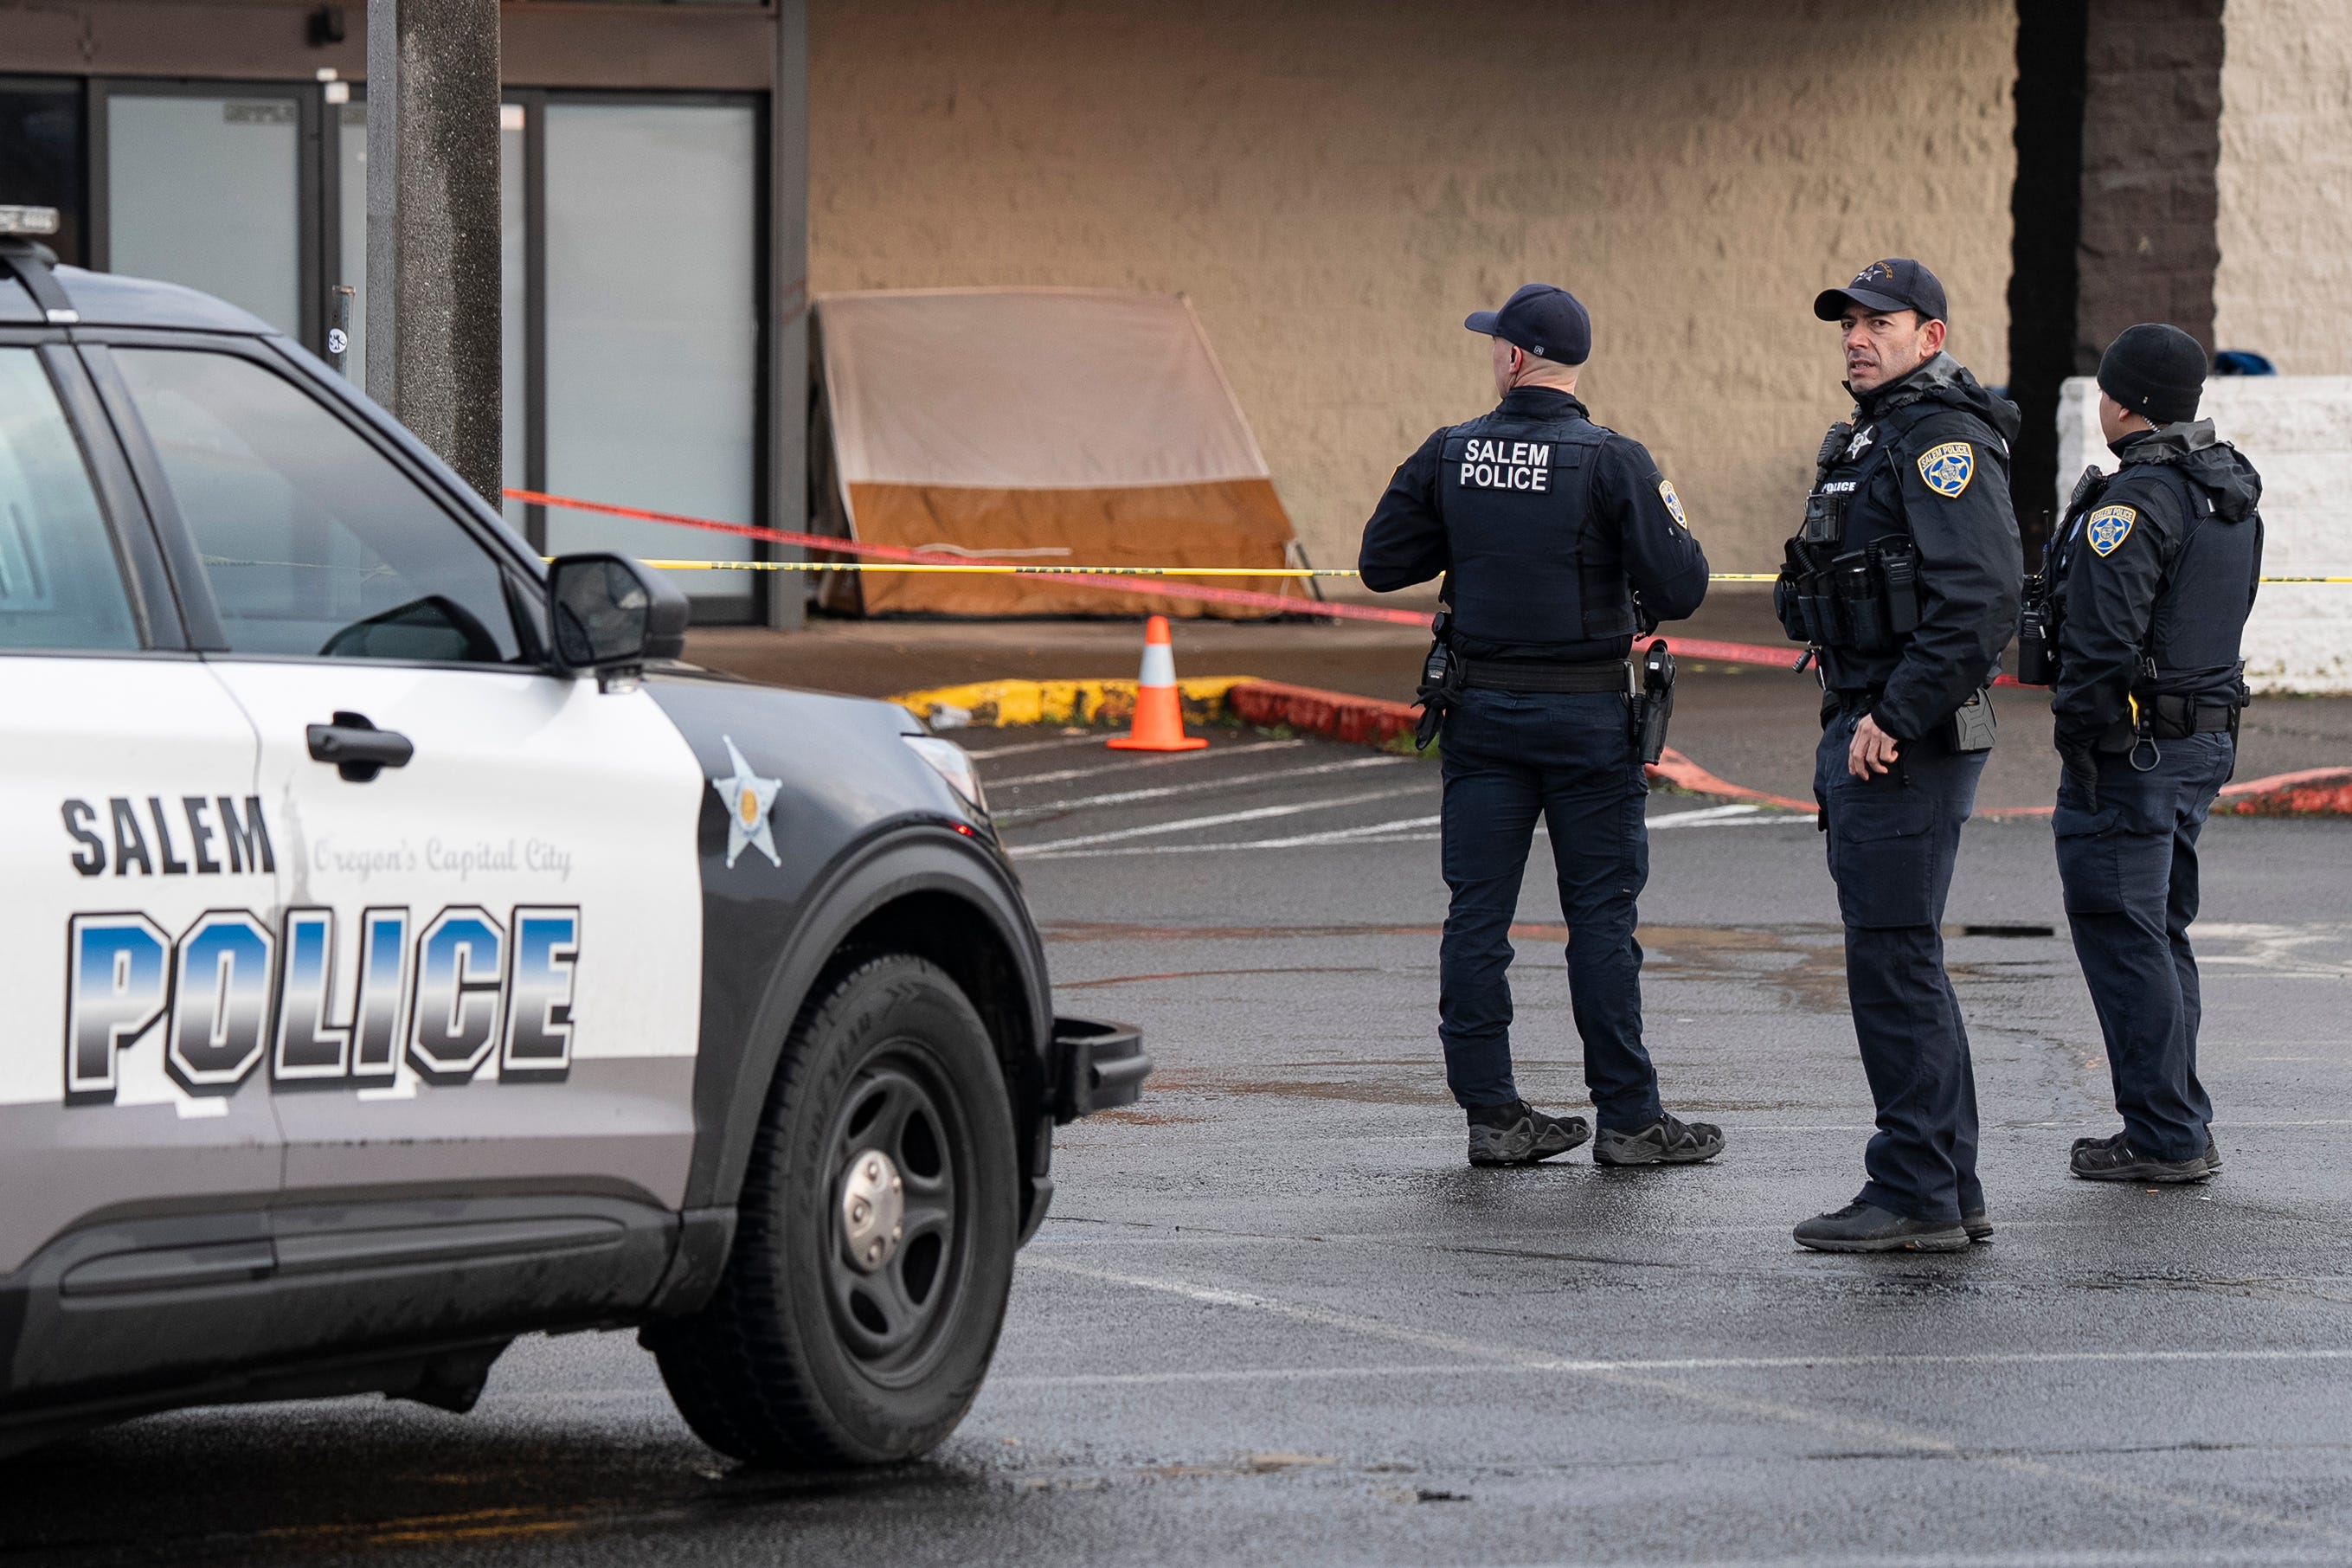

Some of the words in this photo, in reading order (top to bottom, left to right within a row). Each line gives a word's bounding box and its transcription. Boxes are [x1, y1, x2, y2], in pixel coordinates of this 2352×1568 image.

[1465, 439, 1549, 466] SALEM
[1921, 448, 1943, 468] SALEM
[1943, 445, 1969, 455] POLICE
[1460, 463, 1548, 491] POLICE
[61, 796, 276, 877] SALEM
[313, 836, 416, 884] Oregon's
[425, 836, 519, 884] Capital
[524, 836, 573, 884] City
[64, 904, 581, 1107] POLICE
